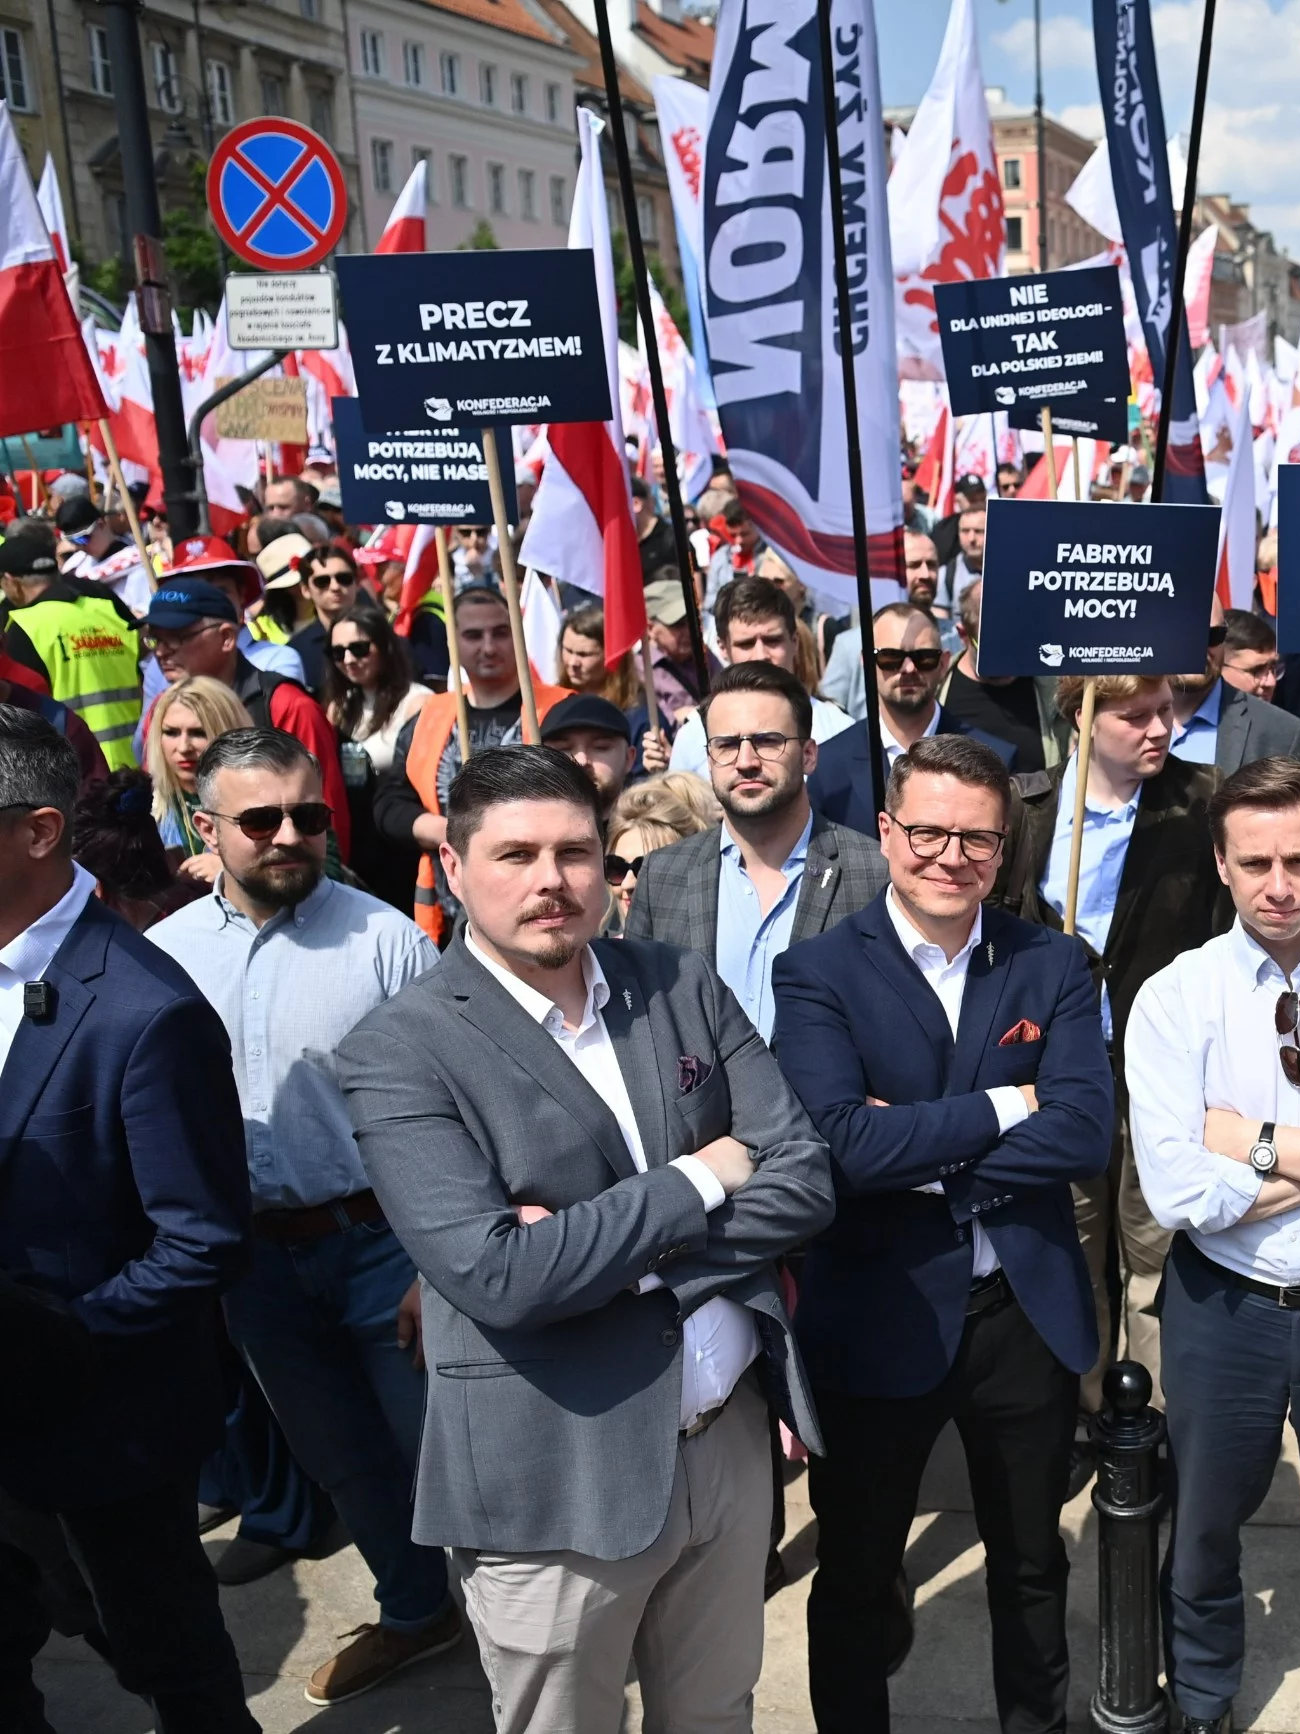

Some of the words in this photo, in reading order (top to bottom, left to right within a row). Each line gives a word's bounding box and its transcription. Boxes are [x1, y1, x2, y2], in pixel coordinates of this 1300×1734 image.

[1010, 284, 1048, 306] NIE
[419, 300, 531, 331] PRECZ
[950, 318, 978, 332] DLA
[980, 311, 1035, 328] UNIJNEJ
[1037, 303, 1103, 322] IDEOLOGII
[375, 344, 393, 364] Z
[397, 336, 582, 364] KLIMATYZMEM!
[1011, 331, 1058, 353] TAK
[972, 362, 1000, 377] DLA
[1001, 355, 1062, 374] POLSKIEJ
[1064, 351, 1103, 366] ZIEMI!
[1018, 380, 1087, 396] KONFEDERACJA
[456, 396, 551, 411] KONFEDERACJA
[368, 442, 482, 462] POTRZEBUJĄ
[354, 464, 409, 482] MOCY,
[411, 464, 441, 480] NIE
[443, 464, 490, 480] HASE
[408, 504, 475, 514] KONFEDERACJA
[1057, 544, 1152, 564] FABRYKI
[1029, 571, 1174, 597] POTRZEBUJĄ
[1064, 599, 1136, 618] MOCY!
[1069, 647, 1153, 658] KONFEDERACJA
